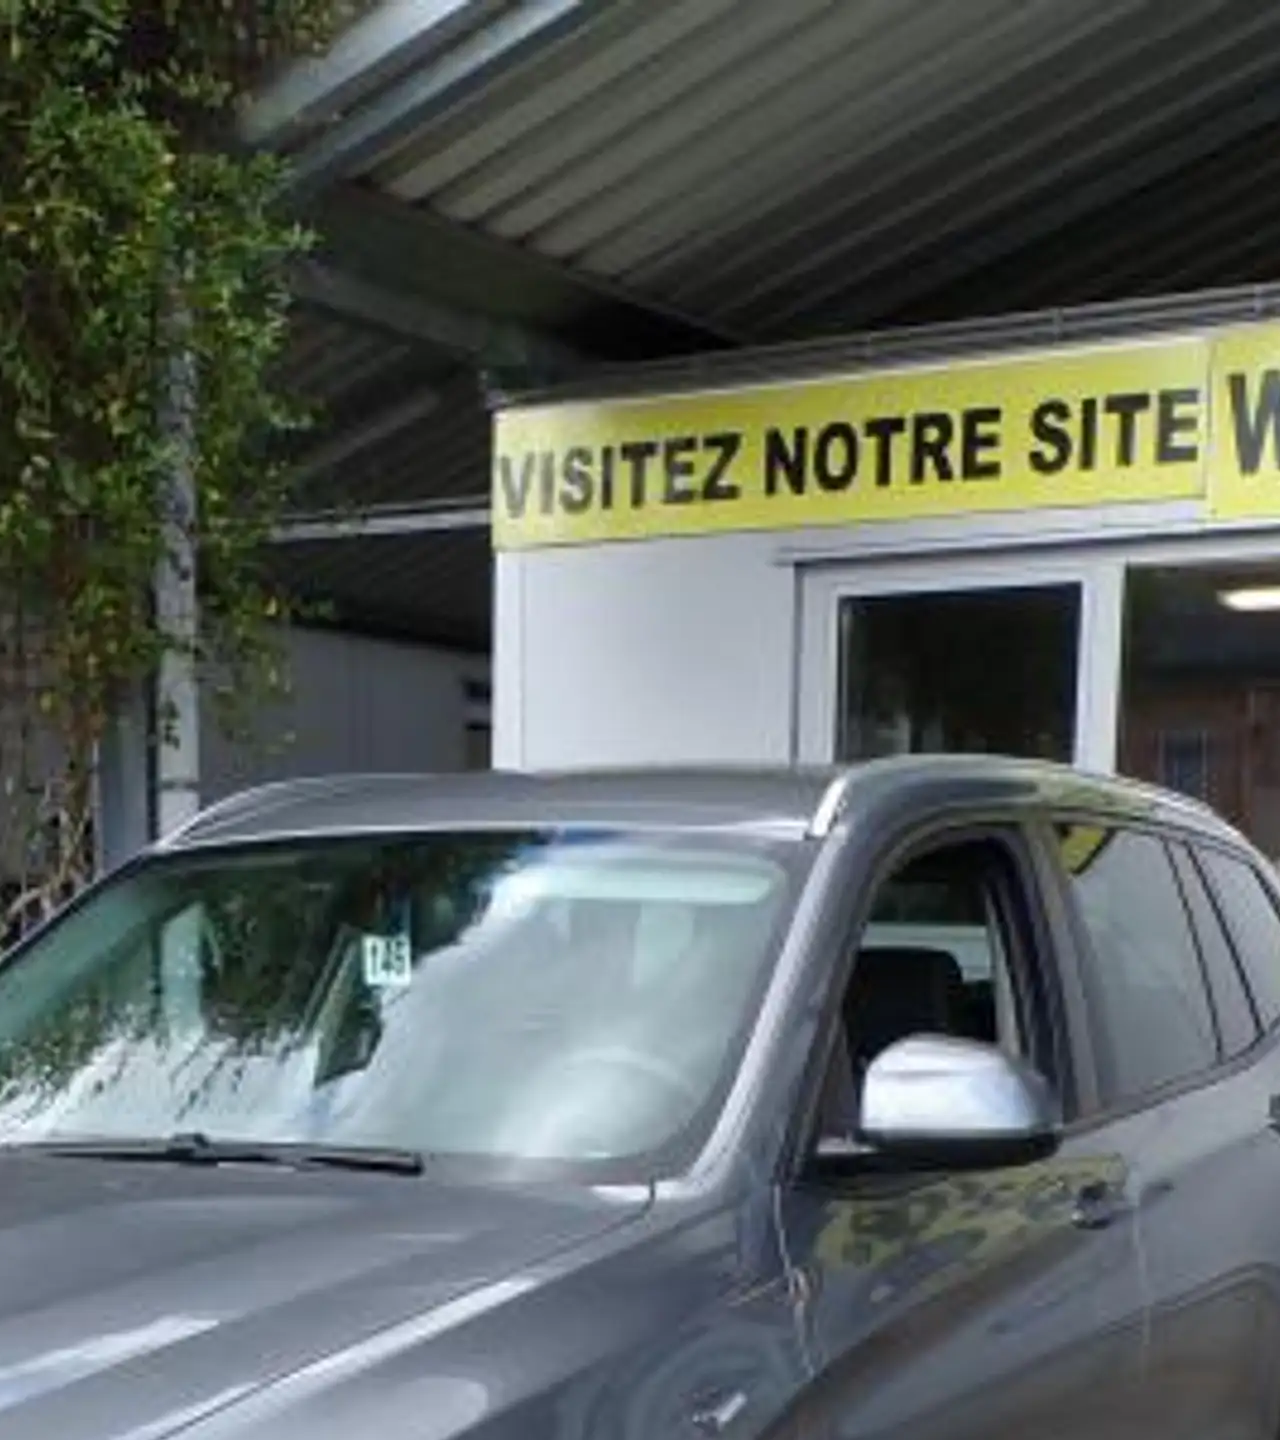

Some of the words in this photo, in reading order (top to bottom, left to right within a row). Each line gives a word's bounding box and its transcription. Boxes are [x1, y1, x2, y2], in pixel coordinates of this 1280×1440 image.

[500, 432, 741, 519] VISITEZ
[764, 408, 1002, 496] NOTRE
[1028, 388, 1199, 476] SITE
